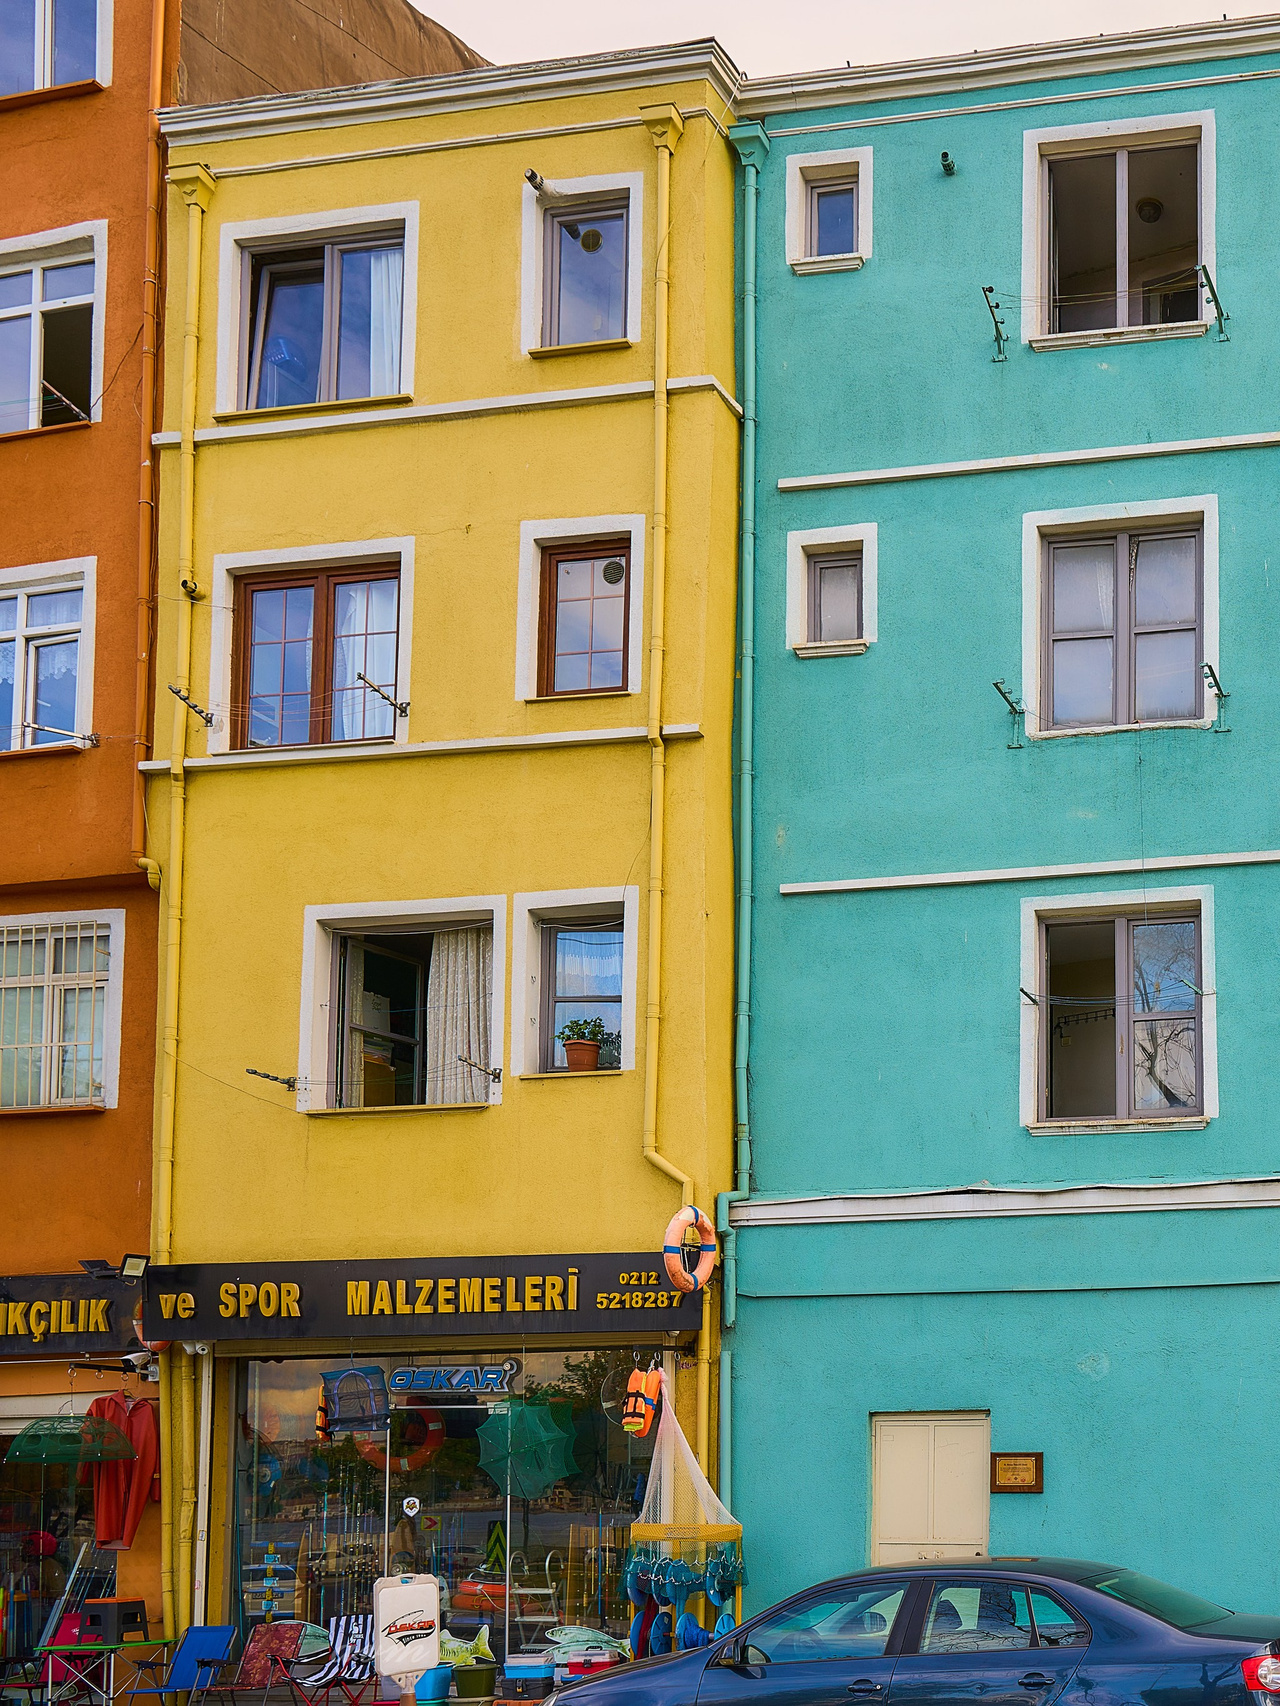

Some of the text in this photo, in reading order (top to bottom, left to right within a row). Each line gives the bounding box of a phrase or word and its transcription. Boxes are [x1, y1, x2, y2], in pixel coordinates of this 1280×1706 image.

[619, 1271, 660, 1286] 0212
[159, 1268, 578, 1319] ve SPOR MALZEMELERİ
[596, 1290, 683, 1310] 5218287
[389, 1367, 505, 1391] OSKAR
[388, 1620, 435, 1634] OSKAR
